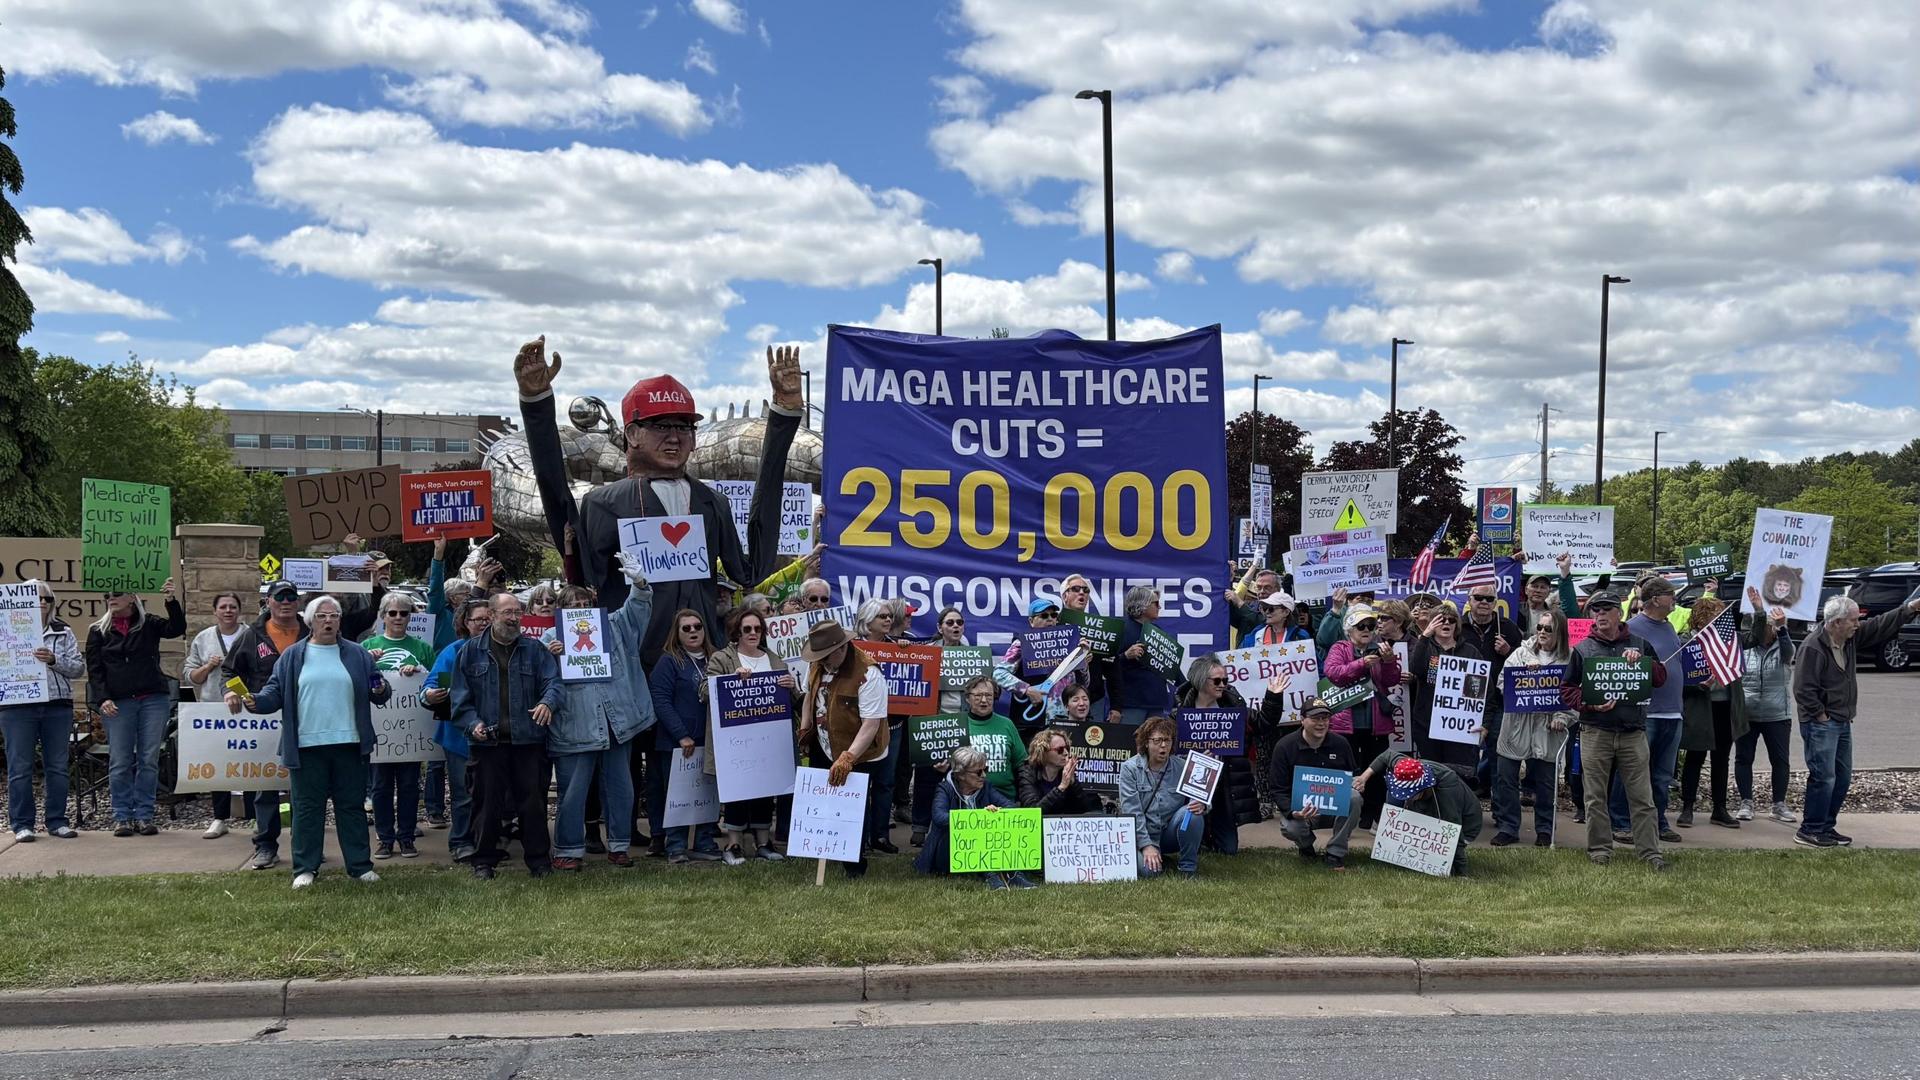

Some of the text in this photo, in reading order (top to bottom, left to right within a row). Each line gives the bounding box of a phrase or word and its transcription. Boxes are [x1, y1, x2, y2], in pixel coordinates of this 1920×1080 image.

[842, 367, 1208, 406] MAGA HEALTHCARE
[648, 391, 686, 403] MAGA
[952, 419, 1065, 458] CUTS
[1307, 474, 1378, 485] DERRICK VAN ORDEN
[298, 472, 387, 508] DUMP
[716, 484, 751, 496] Derek
[1329, 484, 1370, 493] HAZARD!
[425, 491, 470, 508] WE CAN'T
[1321, 496, 1340, 505] FREE
[1362, 494, 1373, 502] TO
[783, 500, 805, 512] CUT
[1368, 501, 1393, 509] HEALTH
[86, 509, 158, 525] cuts will
[416, 506, 480, 524] AFFORD THAT
[840, 466, 1212, 563] 250,000
[1308, 509, 1334, 518] SPEECH
[1369, 510, 1391, 520] CARE
[1530, 511, 1588, 524] Representative
[1784, 516, 1803, 528] THE
[82, 526, 169, 549] shut down
[623, 519, 648, 547] I
[1294, 535, 1322, 545] MAGA
[1353, 531, 1373, 540] CUT
[1566, 540, 1594, 548] Donnie
[1762, 532, 1817, 548] COWARDLY
[1329, 546, 1385, 558] HEALTHCARE
[1526, 551, 1544, 561] Who
[1700, 546, 1715, 555] WE
[82, 550, 162, 572] more WI
[1689, 555, 1728, 567] DESERVE
[1314, 566, 1347, 576] PROVIDE
[1693, 565, 1727, 576] BETTER.
[83, 572, 156, 593] Hospitals
[1331, 577, 1382, 589] WEALTHCARE
[6, 585, 37, 597] WITH
[839, 575, 1212, 617] WISCONSNITES
[567, 610, 593, 619] DERRICK
[1085, 616, 1104, 628] WE
[1042, 629, 1074, 639] TIFFANY
[1031, 641, 1056, 650] VOTED
[1151, 629, 1178, 653] DERRICK
[1035, 648, 1068, 659] CUT OUR
[1144, 634, 1159, 648] VAN
[1159, 645, 1180, 664] ORDEN
[567, 655, 602, 666] ANSWER
[1147, 645, 1173, 668] SOLD US
[1150, 658, 1164, 673] OUT.
[1225, 658, 1317, 683] Be Brave
[1440, 658, 1469, 672] HOW
[1596, 662, 1641, 670] DERRICK
[890, 663, 919, 680] CAN'T
[968, 668, 982, 676] US
[1612, 672, 1648, 680] ORDEN
[723, 680, 743, 689] TOM
[1442, 676, 1461, 690] HE
[1515, 676, 1559, 689] 250,000
[1594, 682, 1640, 690] SOLD US
[731, 685, 776, 698] VOTED TO
[903, 681, 928, 697] THAT
[734, 696, 775, 708] CUT OUR
[1516, 696, 1560, 706] AT RISK
[1604, 692, 1628, 700] OUT.
[1434, 695, 1484, 713] HELPING
[724, 705, 786, 719] HEALTHCARE
[383, 719, 415, 731] over
[920, 719, 959, 730] DERRICK
[1190, 722, 1218, 730] VOTED
[1441, 716, 1475, 733] YOU?
[913, 728, 967, 741] VAN ORDEN
[992, 735, 1007, 744] OFF
[1191, 732, 1209, 740] CUT
[227, 739, 257, 750] HAS
[376, 732, 434, 756] Profits
[921, 739, 959, 750] SOLD US
[1179, 741, 1239, 749] HEALTHCARE
[930, 751, 951, 760] OUT.
[1089, 748, 1131, 760] VAN ORDEN
[188, 762, 289, 780] NO KINGS
[1302, 773, 1344, 784] MEDICAID
[802, 773, 861, 799] Healthcare
[1303, 794, 1338, 810] KILL
[793, 818, 839, 836] Human
[952, 812, 967, 830] Van
[969, 812, 997, 830] Orden
[1051, 820, 1113, 832] VAN ORDEN
[1386, 819, 1449, 844] MEDICAID
[954, 833, 977, 850] Your
[986, 831, 1011, 849] BBB
[1047, 831, 1129, 845] TIFFANY LIE
[1382, 829, 1450, 856] MEDICARE
[1049, 844, 1121, 856] WHILE THEIR
[1398, 845, 1429, 862] NOT
[952, 849, 1040, 870] SICKENING
[1051, 854, 1130, 866] CONSTITUENTS
[1077, 867, 1105, 882] DIE!
